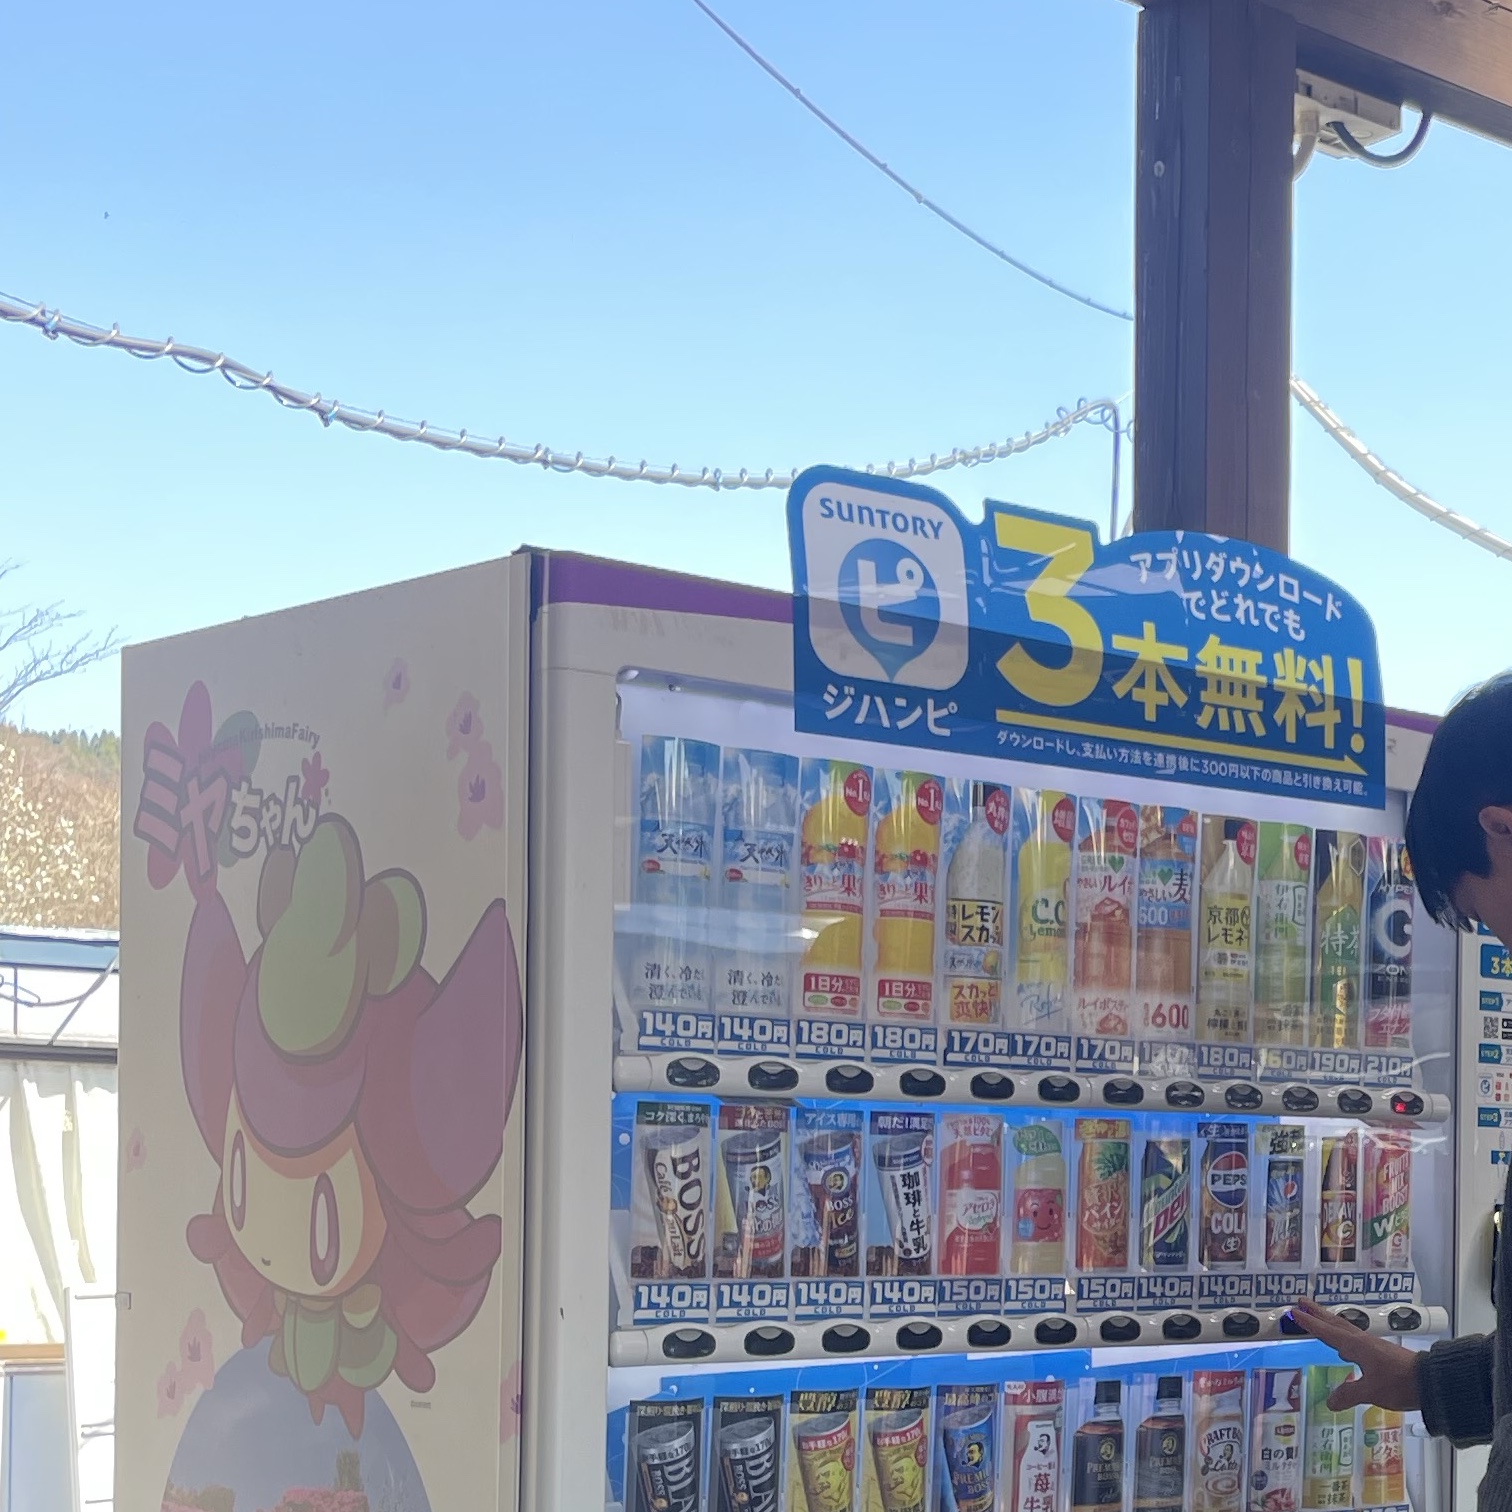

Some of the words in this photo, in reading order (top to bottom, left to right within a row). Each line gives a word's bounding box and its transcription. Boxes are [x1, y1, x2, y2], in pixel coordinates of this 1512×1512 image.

[818, 496, 944, 541] SUNTORY
[1130, 549, 1343, 622] アプリダウンロード
[1181, 587, 1306, 642] でどれでも
[822, 682, 958, 737] ジハンピ
[1207, 927, 1249, 947] レモネ
[642, 1010, 713, 1040] 140円
[720, 1016, 789, 1044] 140円
[799, 1020, 864, 1047] 180円
[874, 1026, 936, 1052] 180円
[952, 1031, 1009, 1055] 170円
[1013, 1034, 1069, 1058] 170円
[1080, 1038, 1133, 1061] 170円
[1202, 1046, 1252, 1068] 180円
[1313, 1053, 1360, 1074] 190円
[1367, 1056, 1413, 1076] 210円
[1211, 1172, 1247, 1186] PEPS
[672, 1149, 706, 1261] BOSS
[899, 1172, 929, 1255] 珈琲と牛乳
[798, 1282, 862, 1305] 140円
[873, 1281, 935, 1303] 140円
[942, 1281, 999, 1301] 150円
[1007, 1279, 1064, 1299] 150円
[1080, 1278, 1132, 1299] 150円
[1140, 1277, 1192, 1297] 140円
[1202, 1275, 1252, 1296] 140円
[1258, 1275, 1306, 1295] 140円
[1318, 1274, 1363, 1293] 140円
[1369, 1273, 1413, 1292] 170円
[639, 1285, 709, 1308] 140円
[719, 1285, 788, 1309] 140円
